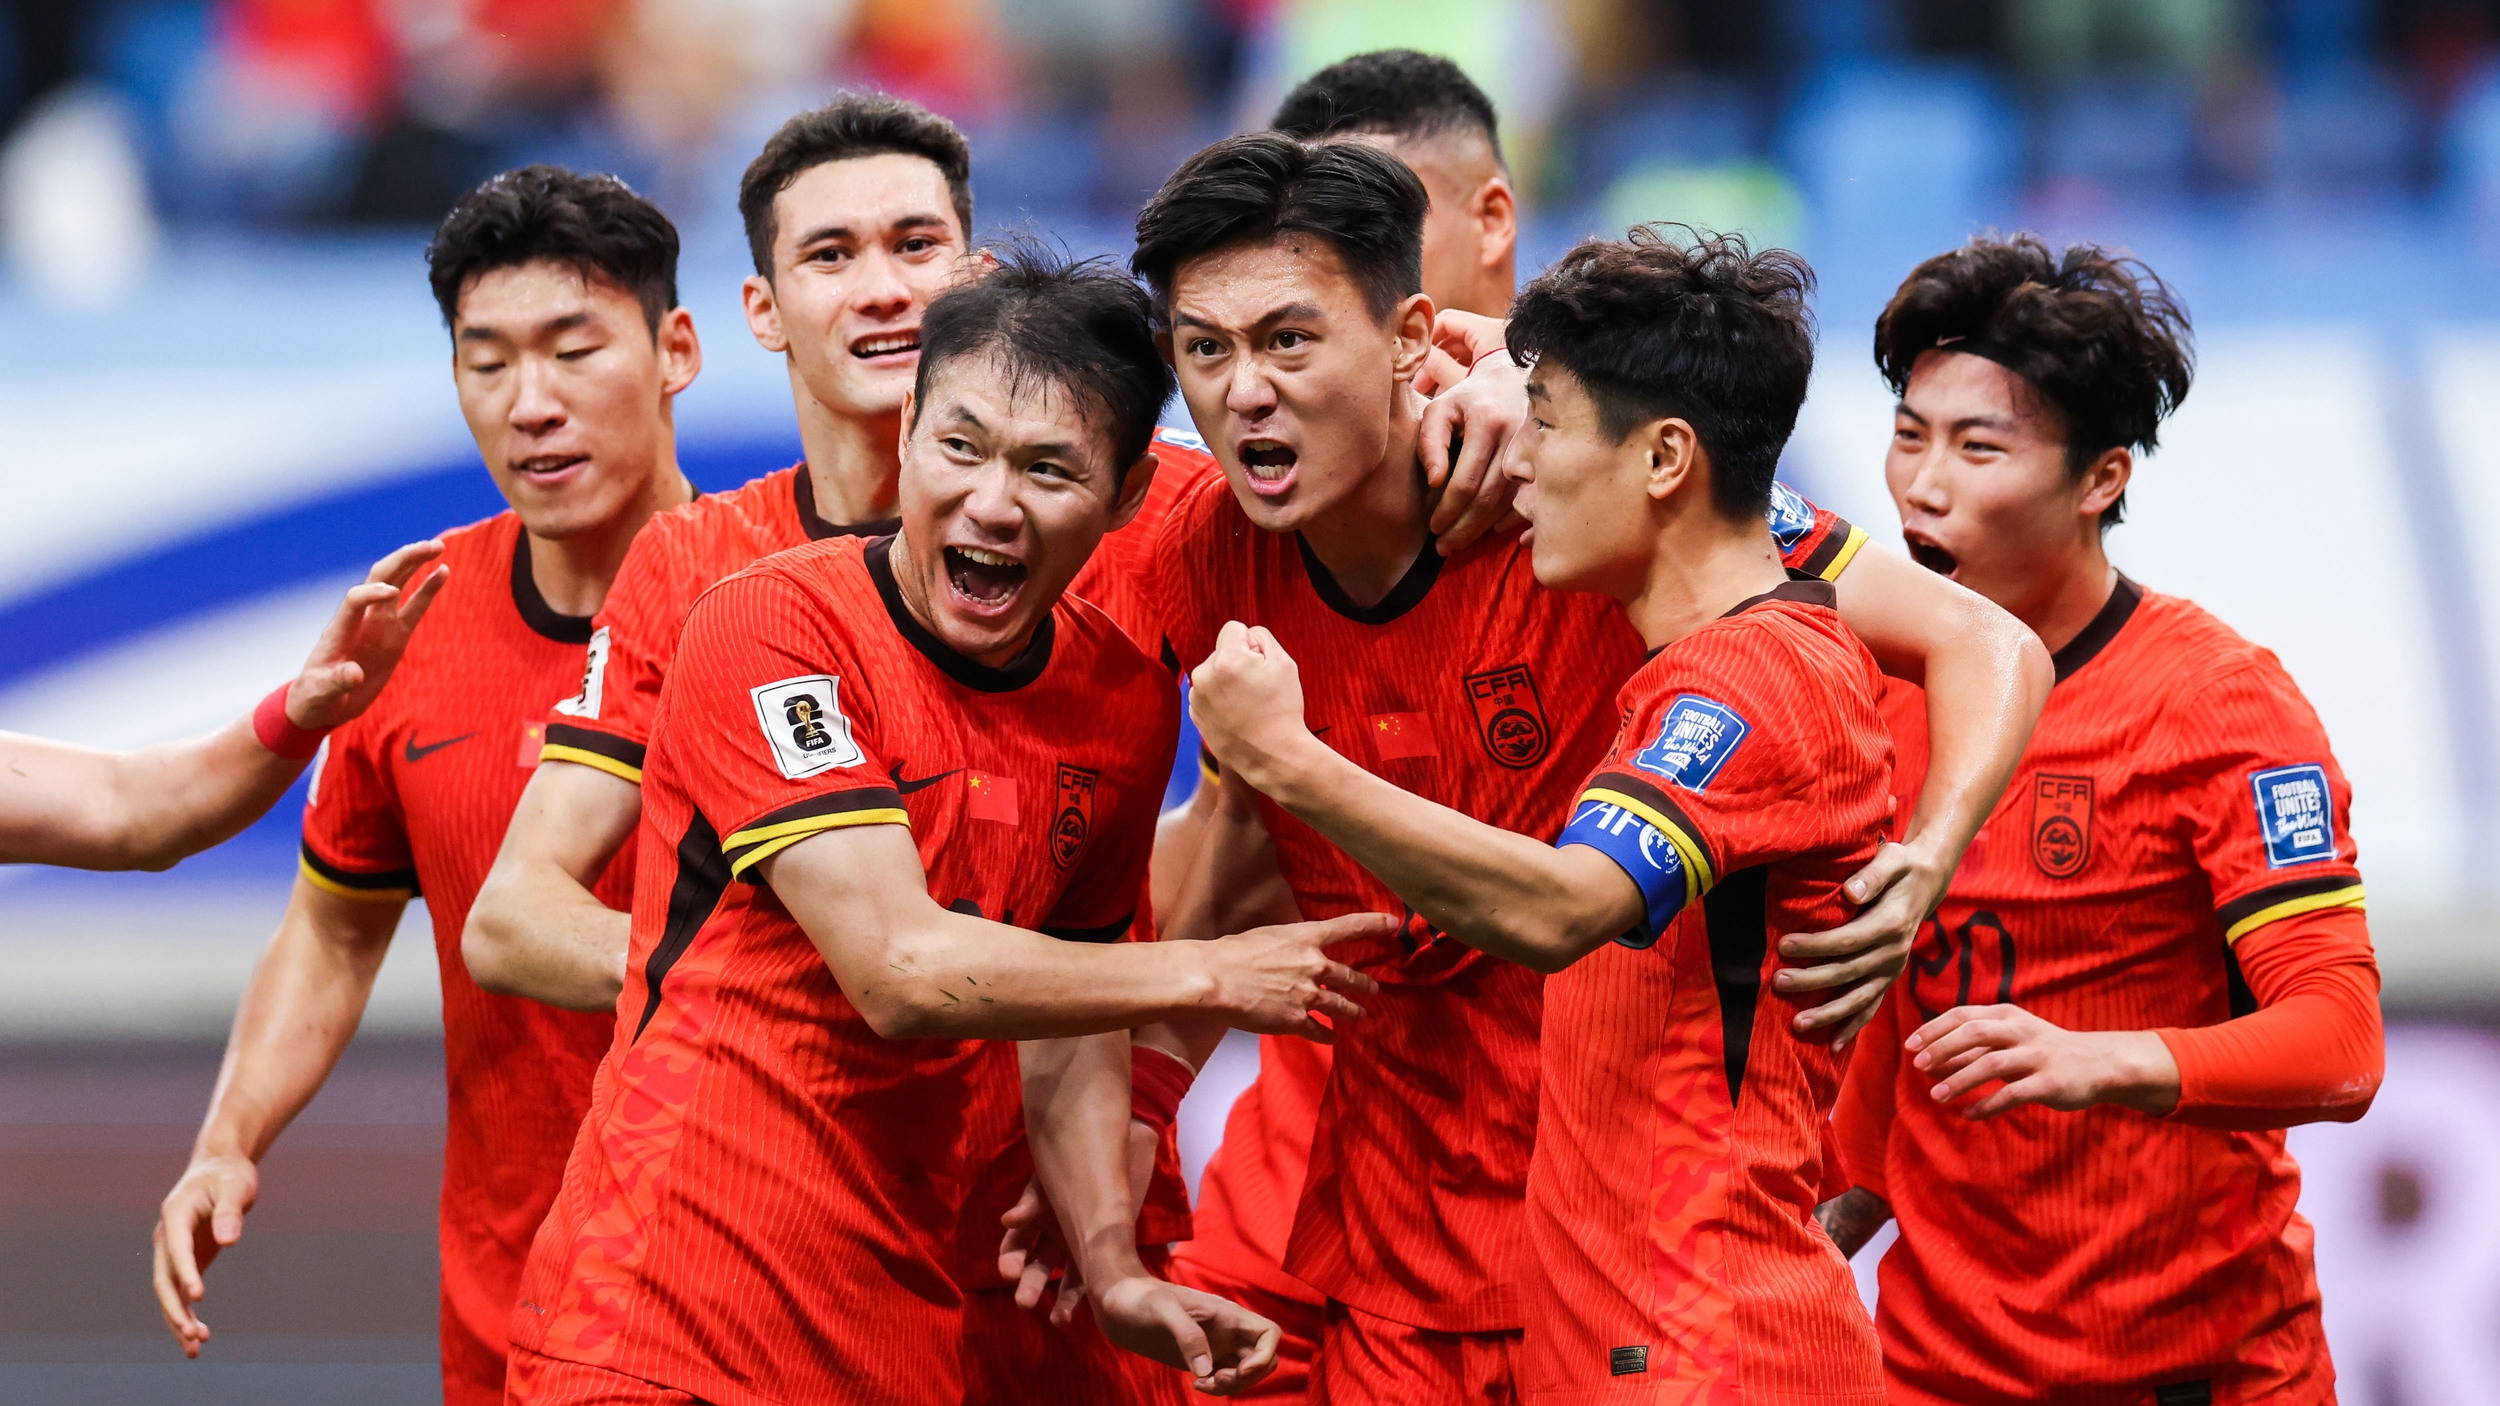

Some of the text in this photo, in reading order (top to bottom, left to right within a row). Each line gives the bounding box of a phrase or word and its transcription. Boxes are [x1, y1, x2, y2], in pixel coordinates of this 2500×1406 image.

[1471, 672, 1528, 699] CFA
[1672, 720, 1719, 751] UNITES
[1680, 708, 1726, 737] FOOTBALL
[806, 737, 825, 748] FIFA
[1663, 736, 1712, 765] the World
[1668, 754, 1686, 765] FIFA
[1061, 769, 1094, 795] CFA
[2040, 780, 2088, 801] CFA
